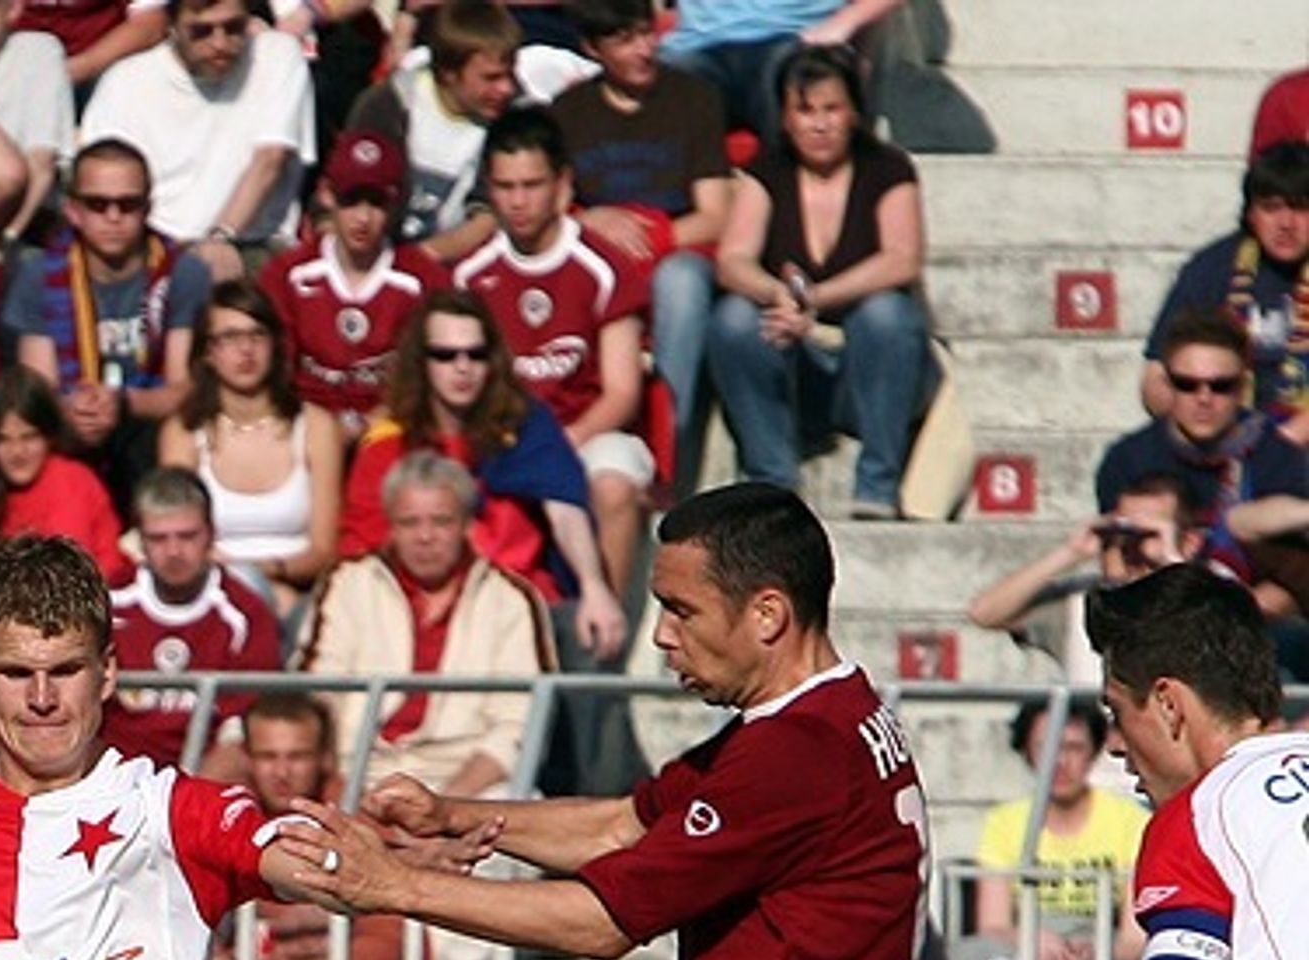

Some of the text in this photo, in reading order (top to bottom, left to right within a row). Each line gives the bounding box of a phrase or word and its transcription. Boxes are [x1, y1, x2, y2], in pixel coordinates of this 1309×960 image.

[1130, 101, 1184, 137] 10
[1068, 282, 1102, 320] 9
[990, 463, 1022, 501] 8
